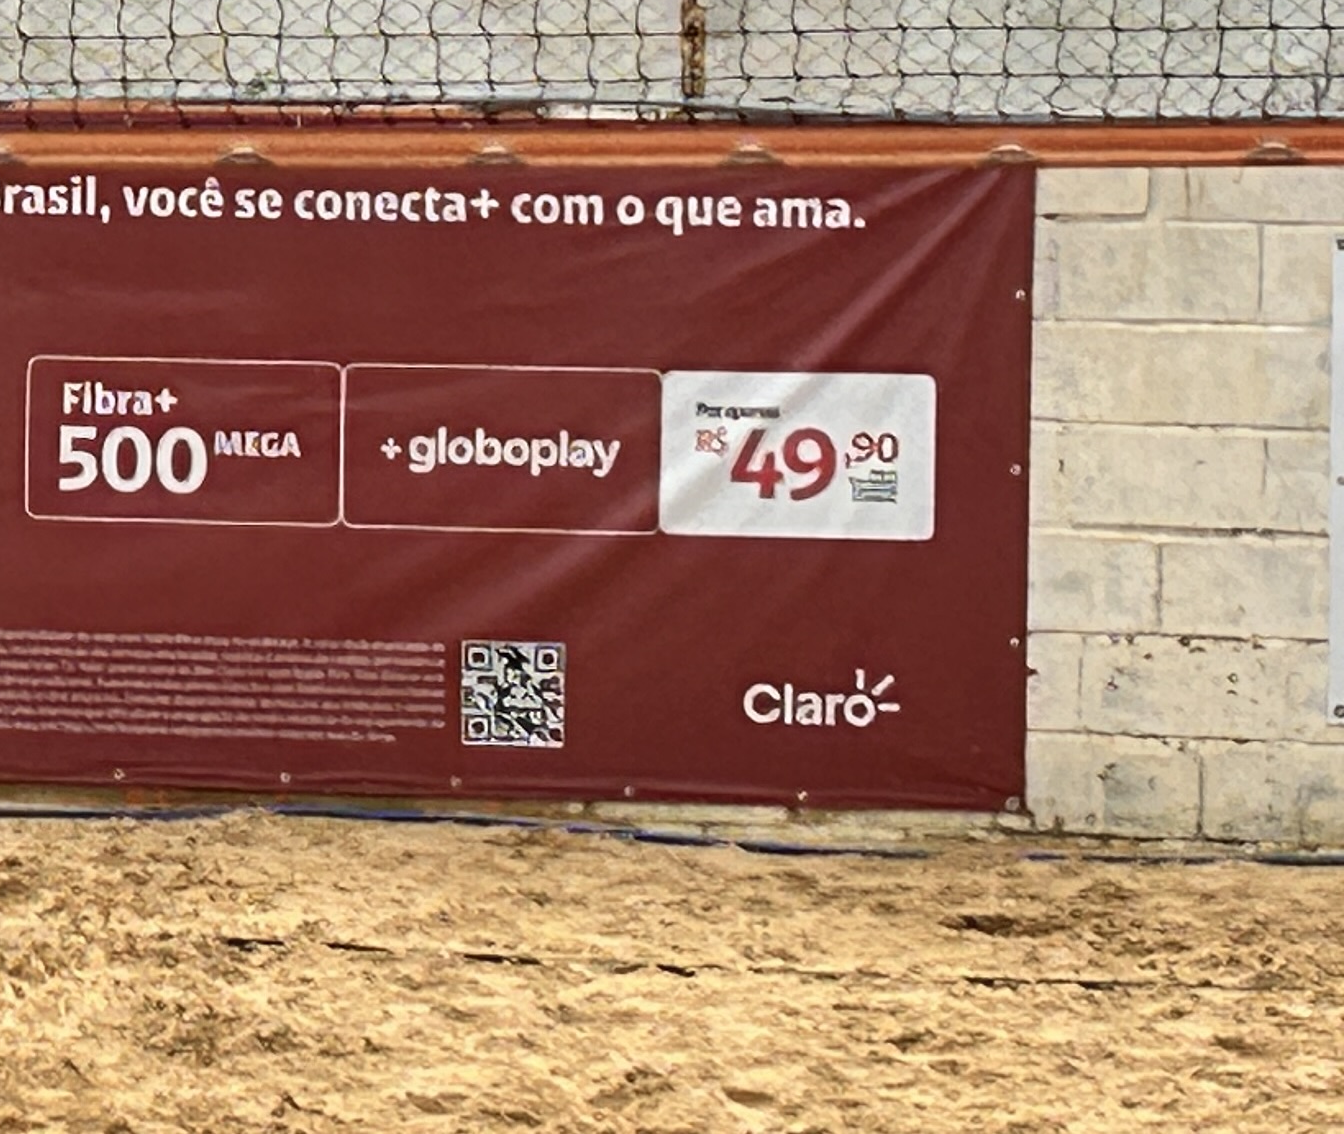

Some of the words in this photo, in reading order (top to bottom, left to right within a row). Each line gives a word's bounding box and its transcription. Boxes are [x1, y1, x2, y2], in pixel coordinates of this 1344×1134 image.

[122, 176, 225, 218] você
[234, 188, 283, 219] se
[510, 192, 604, 226] com
[616, 194, 645, 226] o
[655, 196, 742, 236] que
[752, 197, 866, 229] ama.
[58, 424, 209, 494] 500
[213, 430, 302, 458] MEGA
[743, 681, 877, 727] Claro
